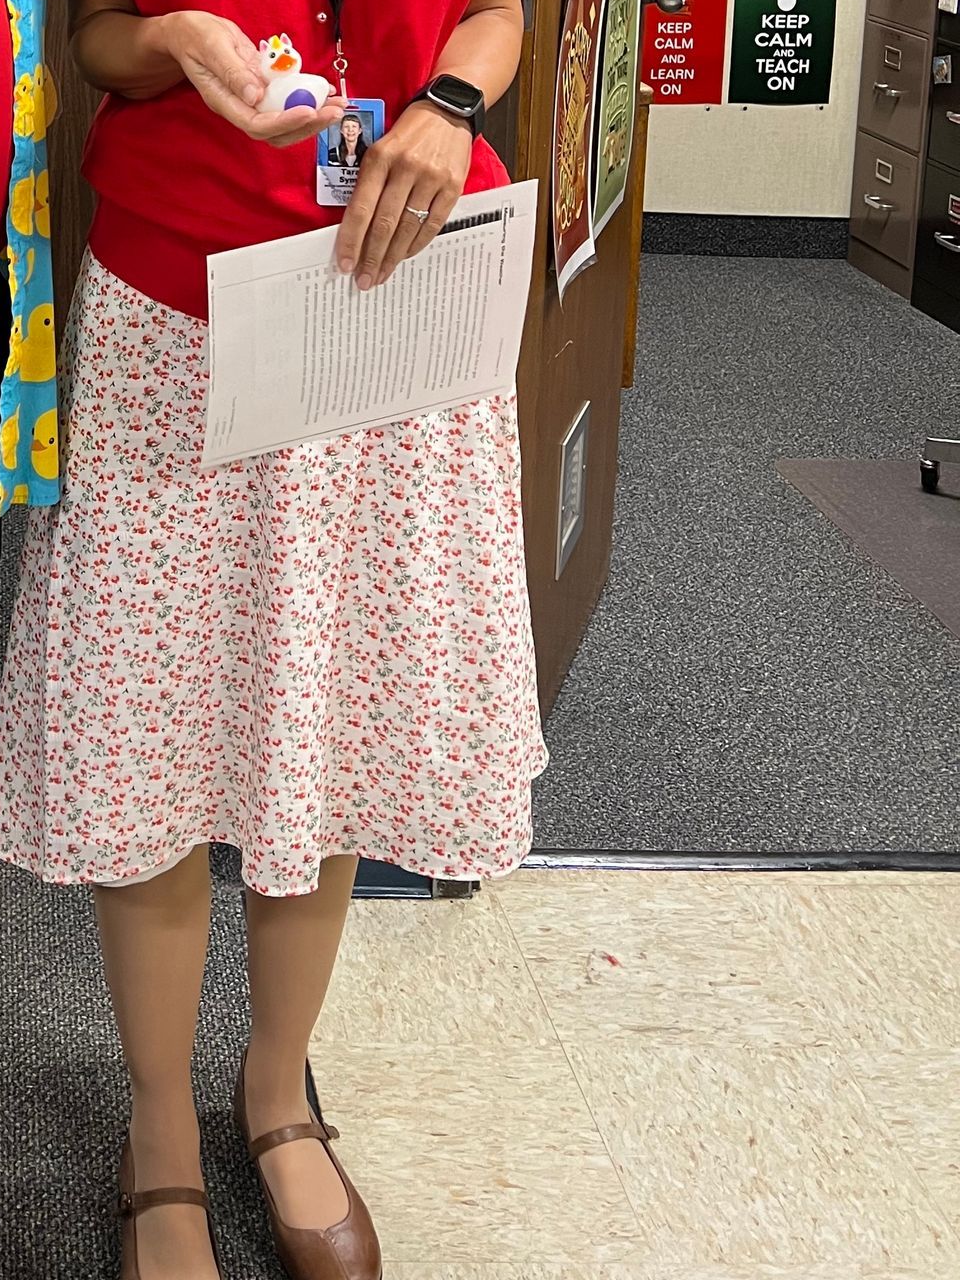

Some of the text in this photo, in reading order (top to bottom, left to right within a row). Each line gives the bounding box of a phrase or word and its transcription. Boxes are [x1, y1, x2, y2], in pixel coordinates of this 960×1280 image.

[761, 14, 810, 29] KEEP
[657, 22, 693, 34] KEEP
[654, 37, 694, 50] CALM
[754, 32, 813, 48] CALM
[661, 54, 686, 64] AND
[773, 48, 795, 58] AND
[755, 58, 810, 74] TEACH
[650, 68, 695, 80] LEARN
[660, 83, 682, 95] ON
[767, 76, 796, 91] ON
[339, 176, 358, 185] Sym
